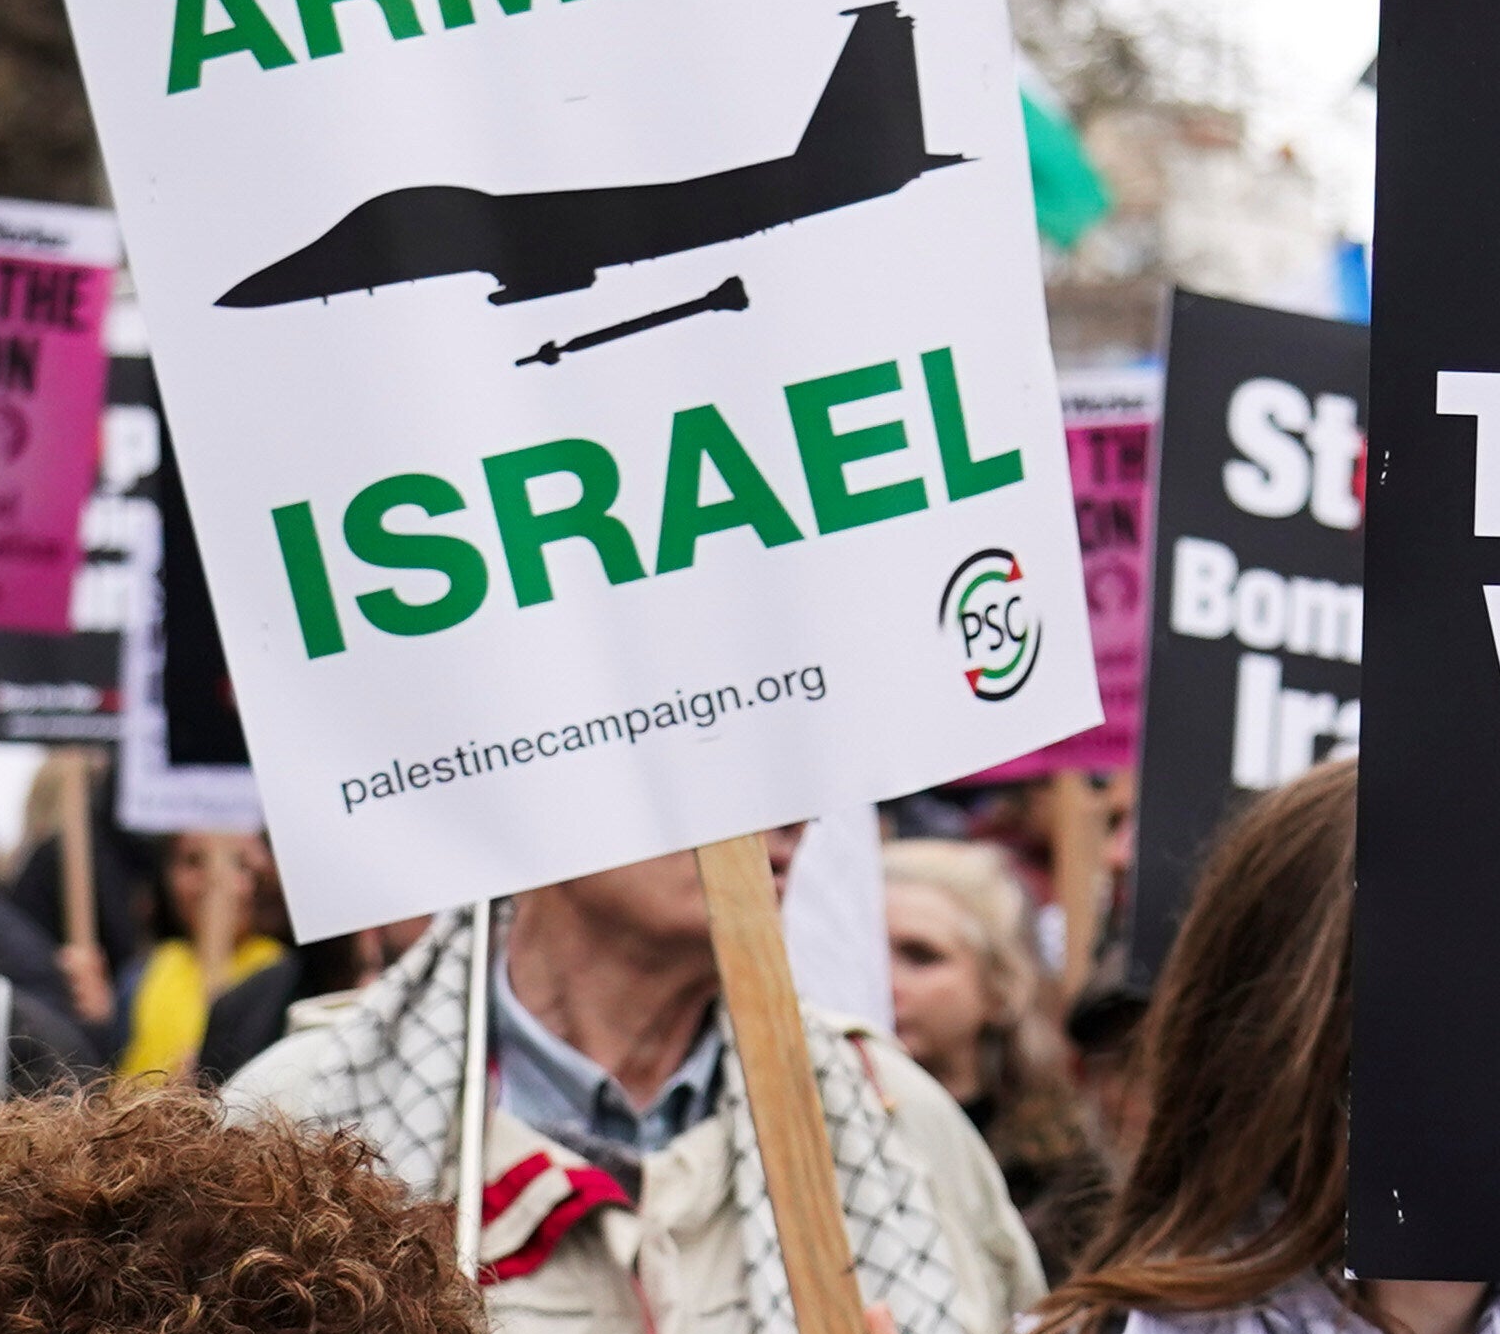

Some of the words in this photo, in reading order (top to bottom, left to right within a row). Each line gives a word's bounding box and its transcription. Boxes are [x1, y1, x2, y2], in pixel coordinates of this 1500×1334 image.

[270, 346, 1024, 660] ISRAEL
[959, 595, 1027, 658] PSC
[340, 665, 827, 814] palestinecampaign.org
